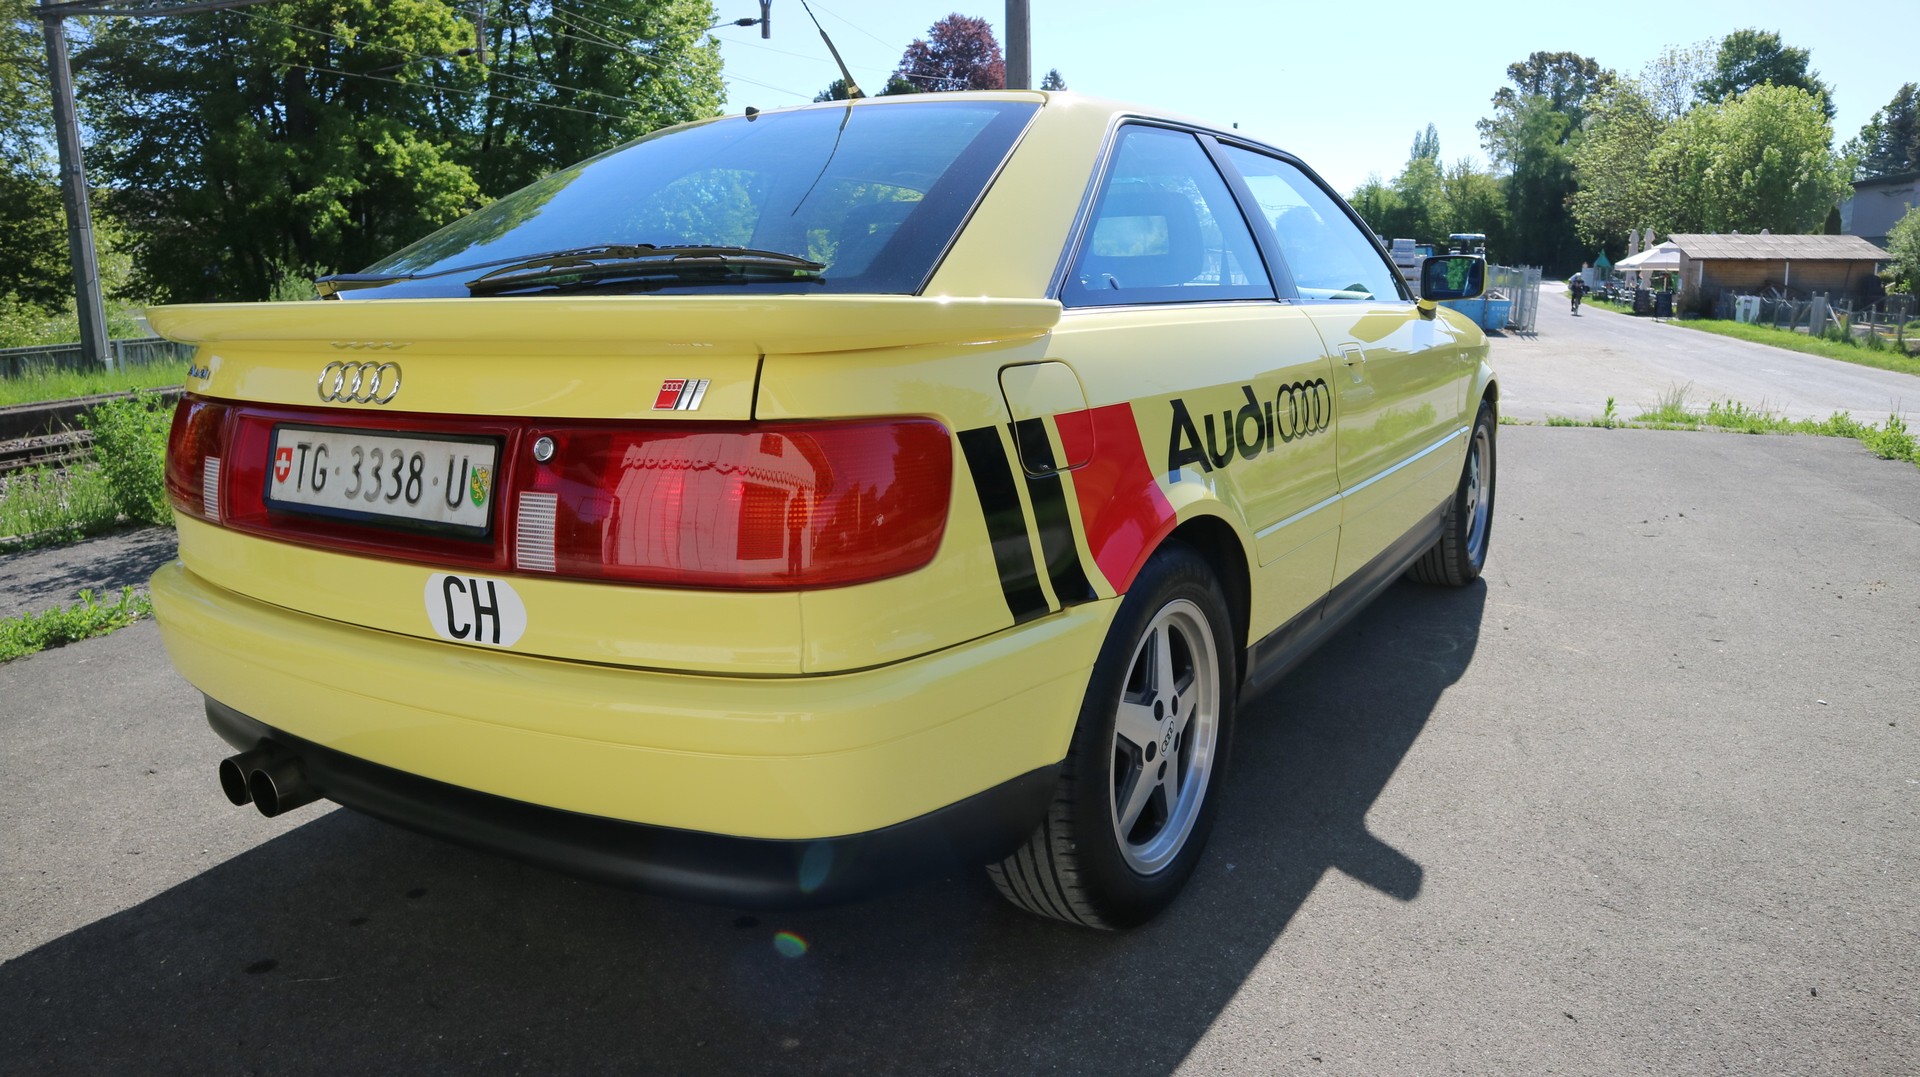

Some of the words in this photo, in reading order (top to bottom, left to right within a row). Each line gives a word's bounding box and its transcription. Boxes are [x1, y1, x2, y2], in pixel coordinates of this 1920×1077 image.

[1168, 385, 1275, 484] Audi
[297, 441, 329, 493] TG
[344, 445, 426, 507] 3338
[445, 454, 470, 511] U
[443, 576, 500, 644] CH
